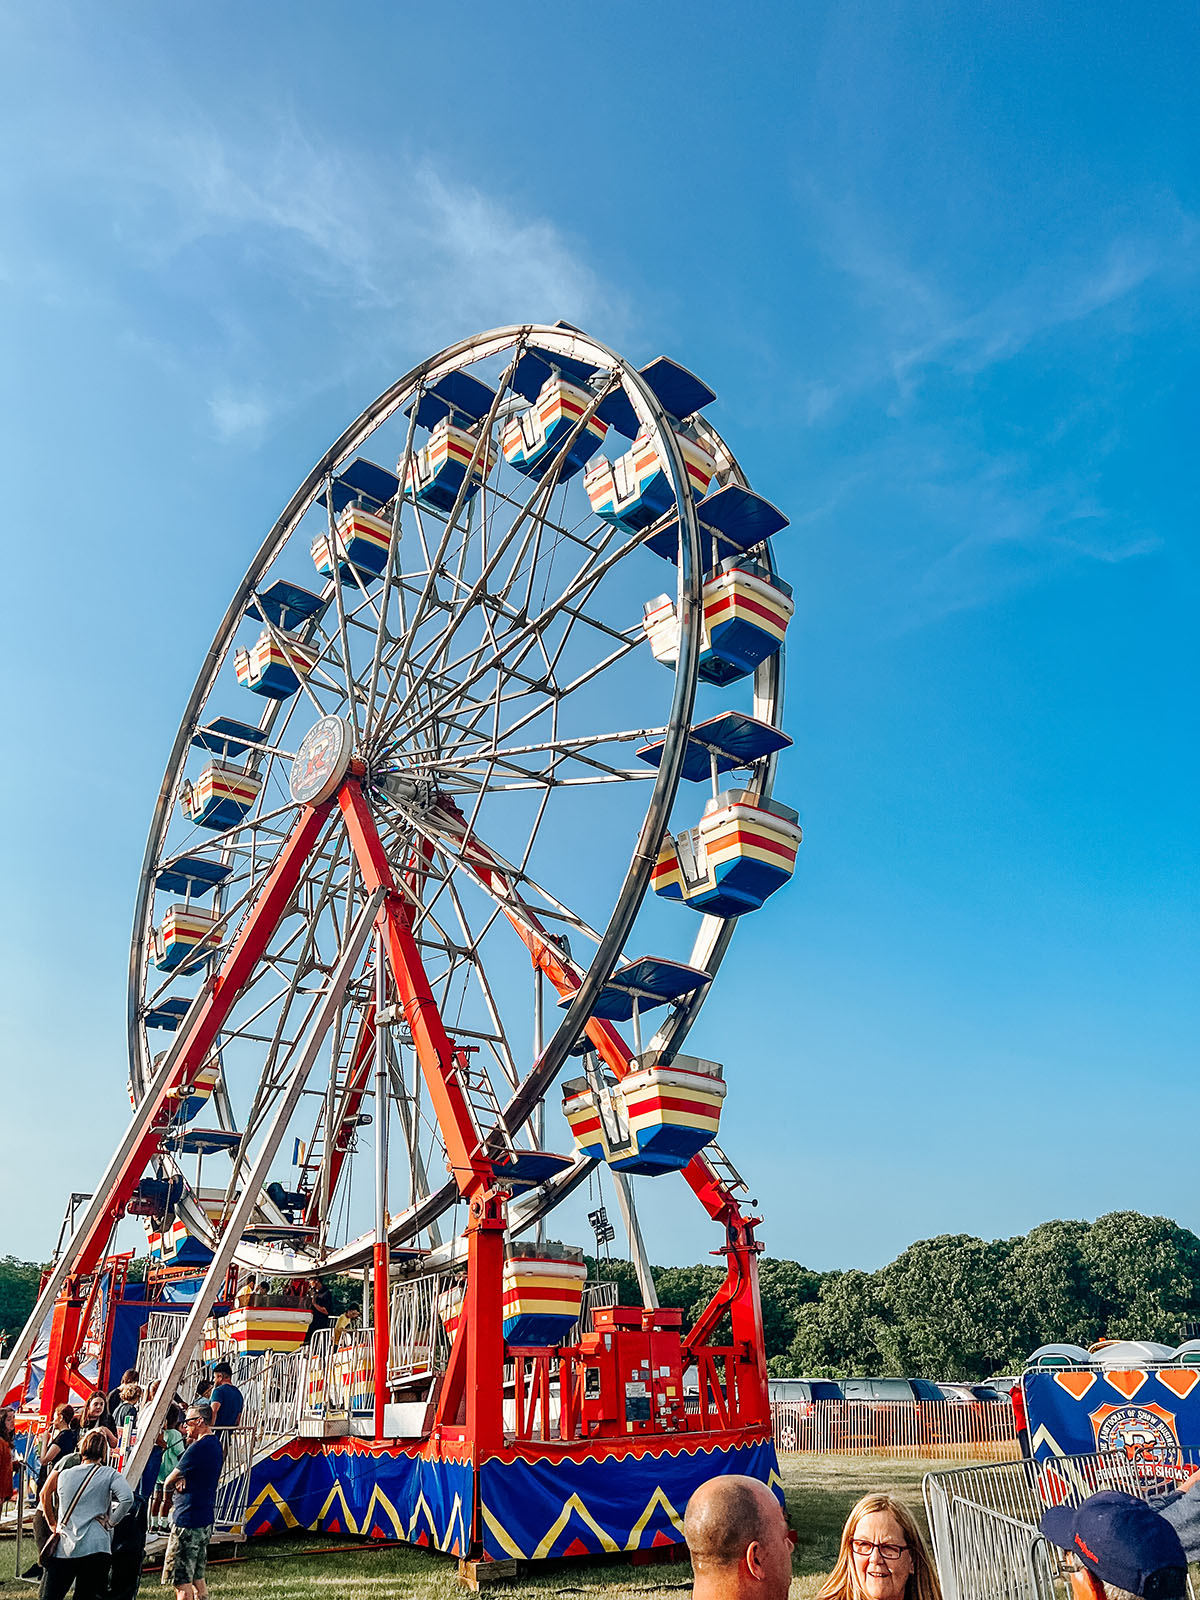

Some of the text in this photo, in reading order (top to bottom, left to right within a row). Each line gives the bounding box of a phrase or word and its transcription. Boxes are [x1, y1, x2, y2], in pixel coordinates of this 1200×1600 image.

[1127, 1410, 1136, 1418] OF
[1137, 1410, 1158, 1425] SHOW
[1156, 1465, 1187, 1481] SHOWS
